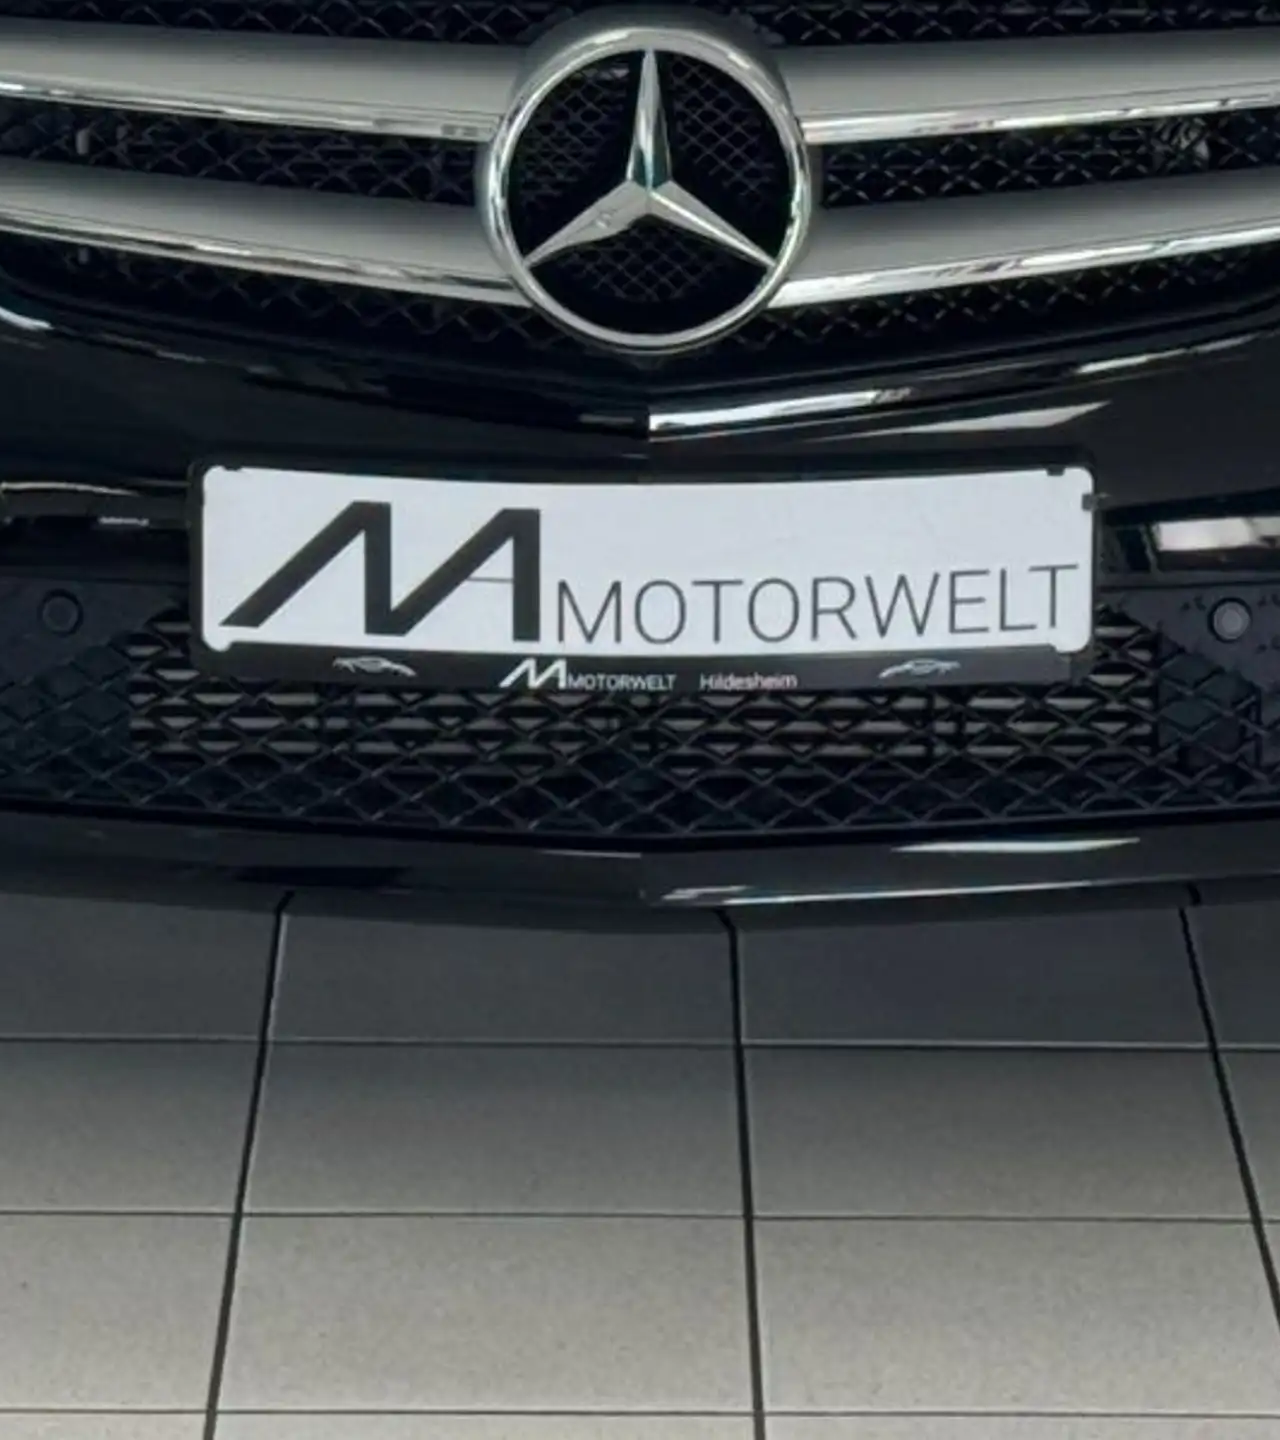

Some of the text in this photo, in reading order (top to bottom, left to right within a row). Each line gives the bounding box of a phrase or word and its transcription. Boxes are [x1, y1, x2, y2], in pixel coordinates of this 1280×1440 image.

[556, 563, 1080, 645] MOTORWELT
[569, 673, 676, 692] MOTORWELT
[700, 672, 799, 691] Hildesheim
